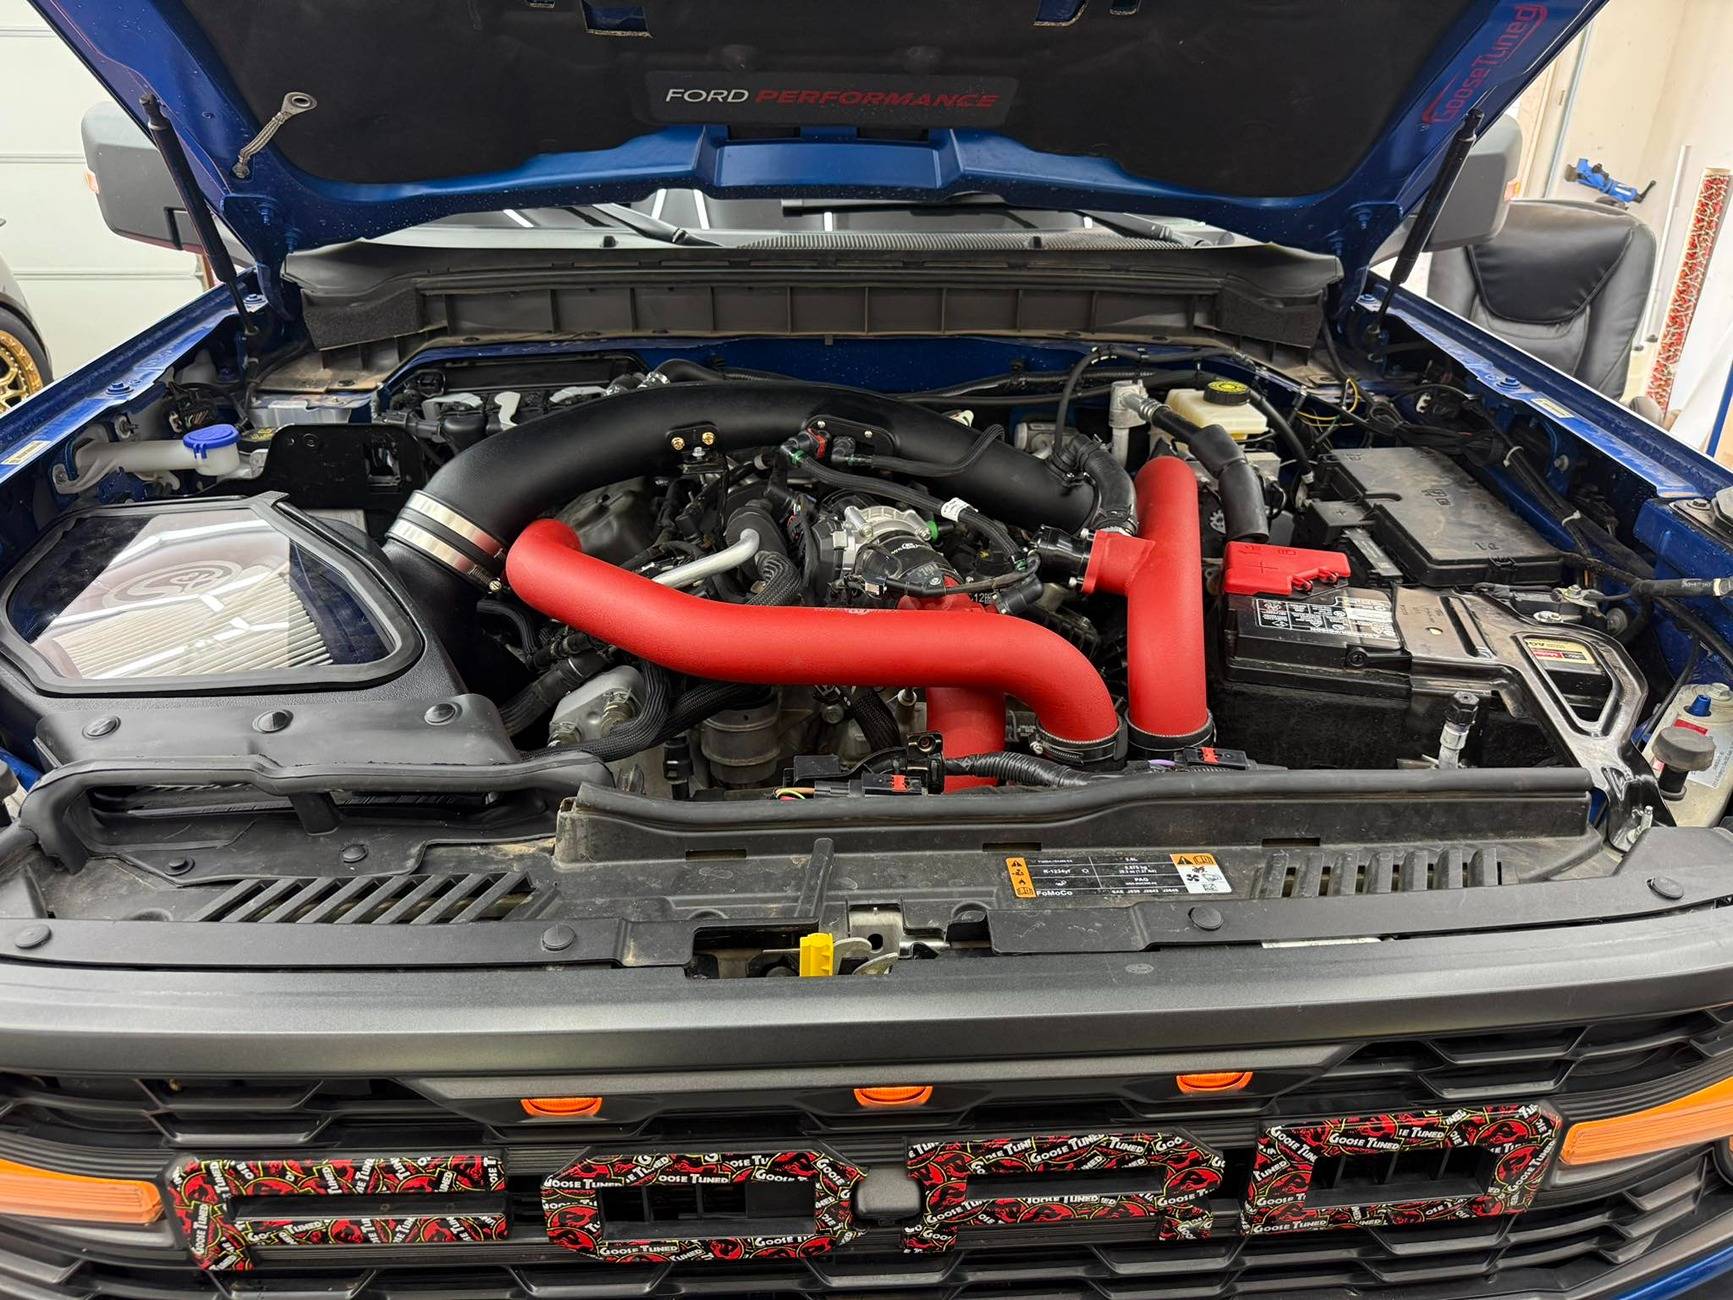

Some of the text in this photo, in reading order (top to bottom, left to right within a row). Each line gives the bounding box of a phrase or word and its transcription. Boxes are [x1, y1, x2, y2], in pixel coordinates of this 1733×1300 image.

[665, 88, 1000, 109] FORD PERFORMANCE
[1109, 1136, 1144, 1153] TUNED
[1328, 1133, 1401, 1150] GOOSE TUNED
[1029, 1145, 1069, 1163] GOOSE
[689, 1173, 729, 1184] TUNED
[816, 1158, 846, 1186] GOOSE
[1253, 1160, 1287, 1181] TUNED
[1507, 1166, 1535, 1192] GOOSE
[926, 1206, 963, 1224] GOOSE
[1292, 1219, 1327, 1229] TUNED
[283, 1220, 322, 1235] TUNED
